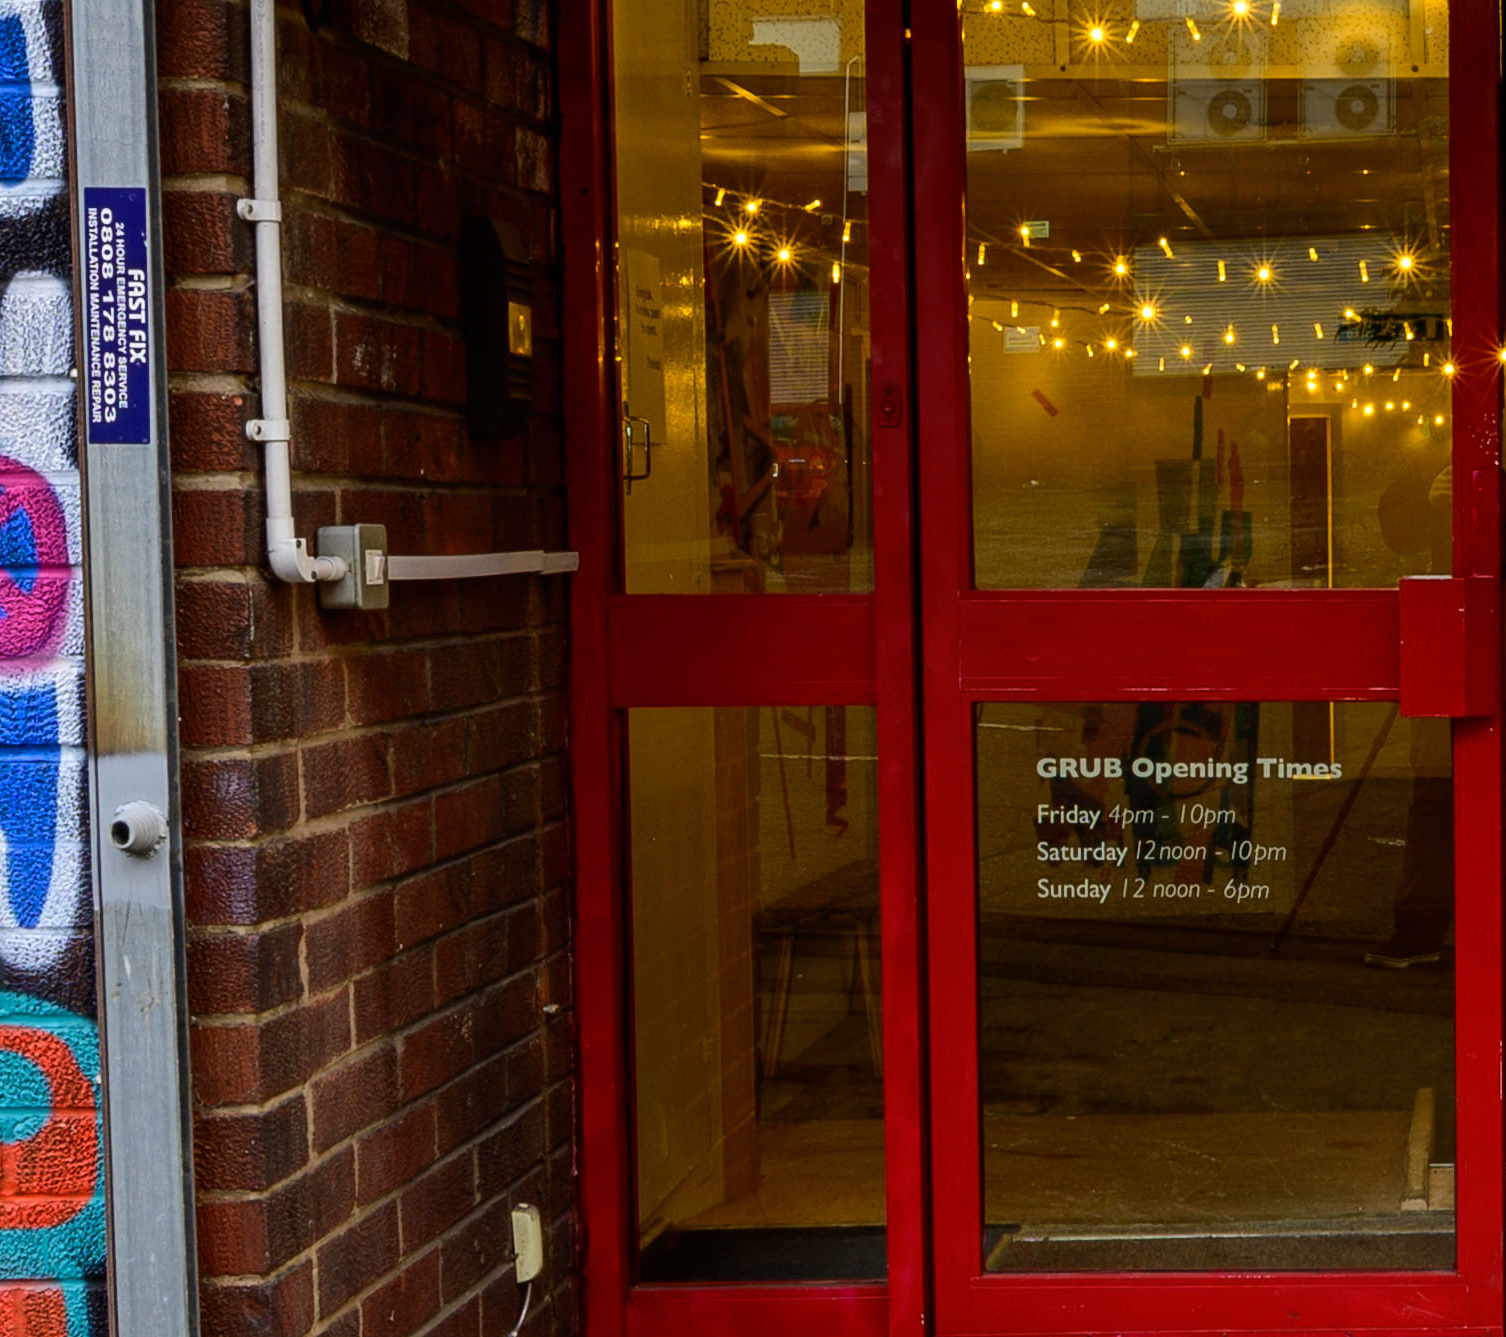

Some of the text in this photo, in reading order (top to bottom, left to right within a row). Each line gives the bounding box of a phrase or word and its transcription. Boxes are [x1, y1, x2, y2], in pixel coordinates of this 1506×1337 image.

[88, 208, 102, 423] INSTALLATION MAINTENANCE REPAIR
[100, 207, 116, 423] 0808 178 8303
[115, 221, 129, 408] 24 HOUR EMERGENCY SERVICE
[128, 269, 147, 364] FAST FIX
[1036, 757, 1342, 784] GRUB Opening Times
[1037, 804, 1101, 830] Friday
[1108, 804, 1154, 829] 4pm
[1179, 804, 1236, 829] 10pm
[1037, 841, 1128, 867] Saturday
[1231, 840, 1287, 866] 10pm
[1037, 878, 1112, 904] Sunday
[1122, 877, 1145, 898] 12
[1153, 883, 1201, 898] noon
[1223, 878, 1270, 904] 6pm
